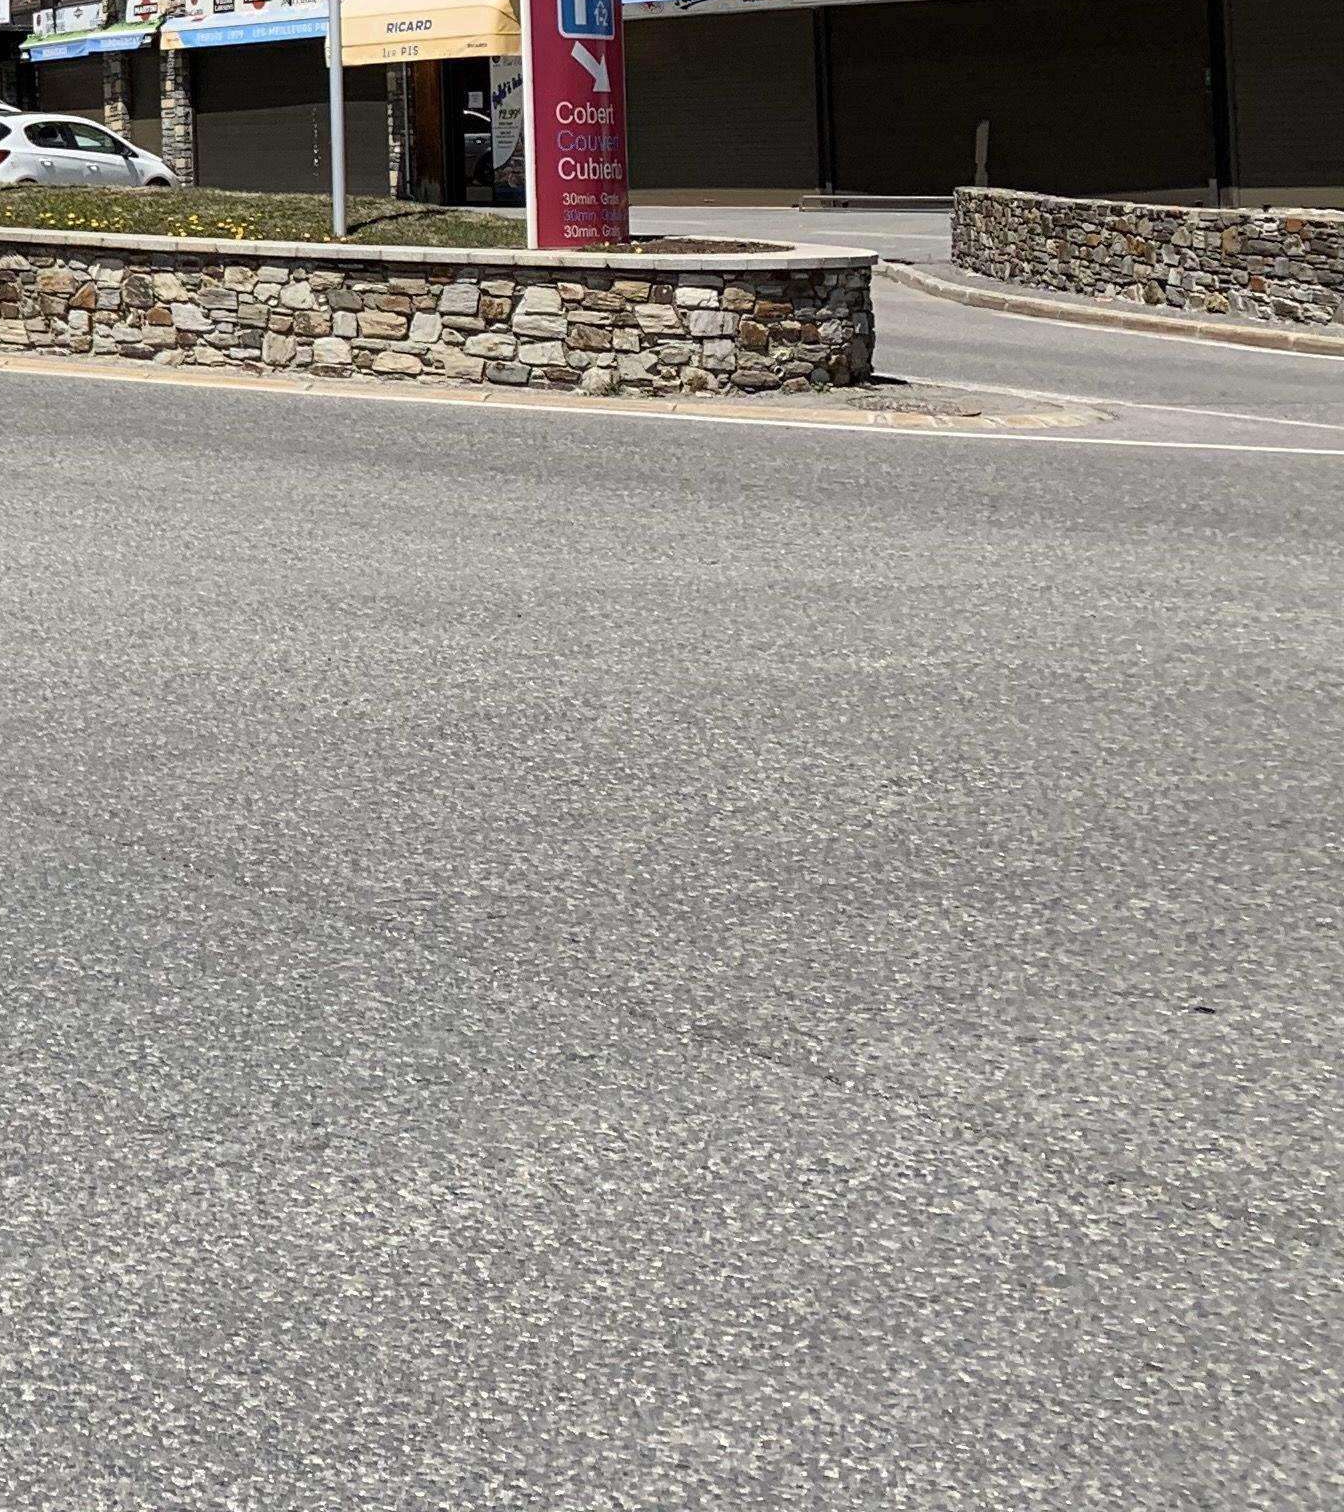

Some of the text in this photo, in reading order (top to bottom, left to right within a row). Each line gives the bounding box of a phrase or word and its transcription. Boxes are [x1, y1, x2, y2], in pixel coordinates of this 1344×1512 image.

[386, 19, 433, 34] RICARD
[555, 101, 615, 125] Cobert
[557, 156, 623, 180] Cubierto
[562, 192, 598, 206] 30min.
[564, 224, 600, 238] 30min.
